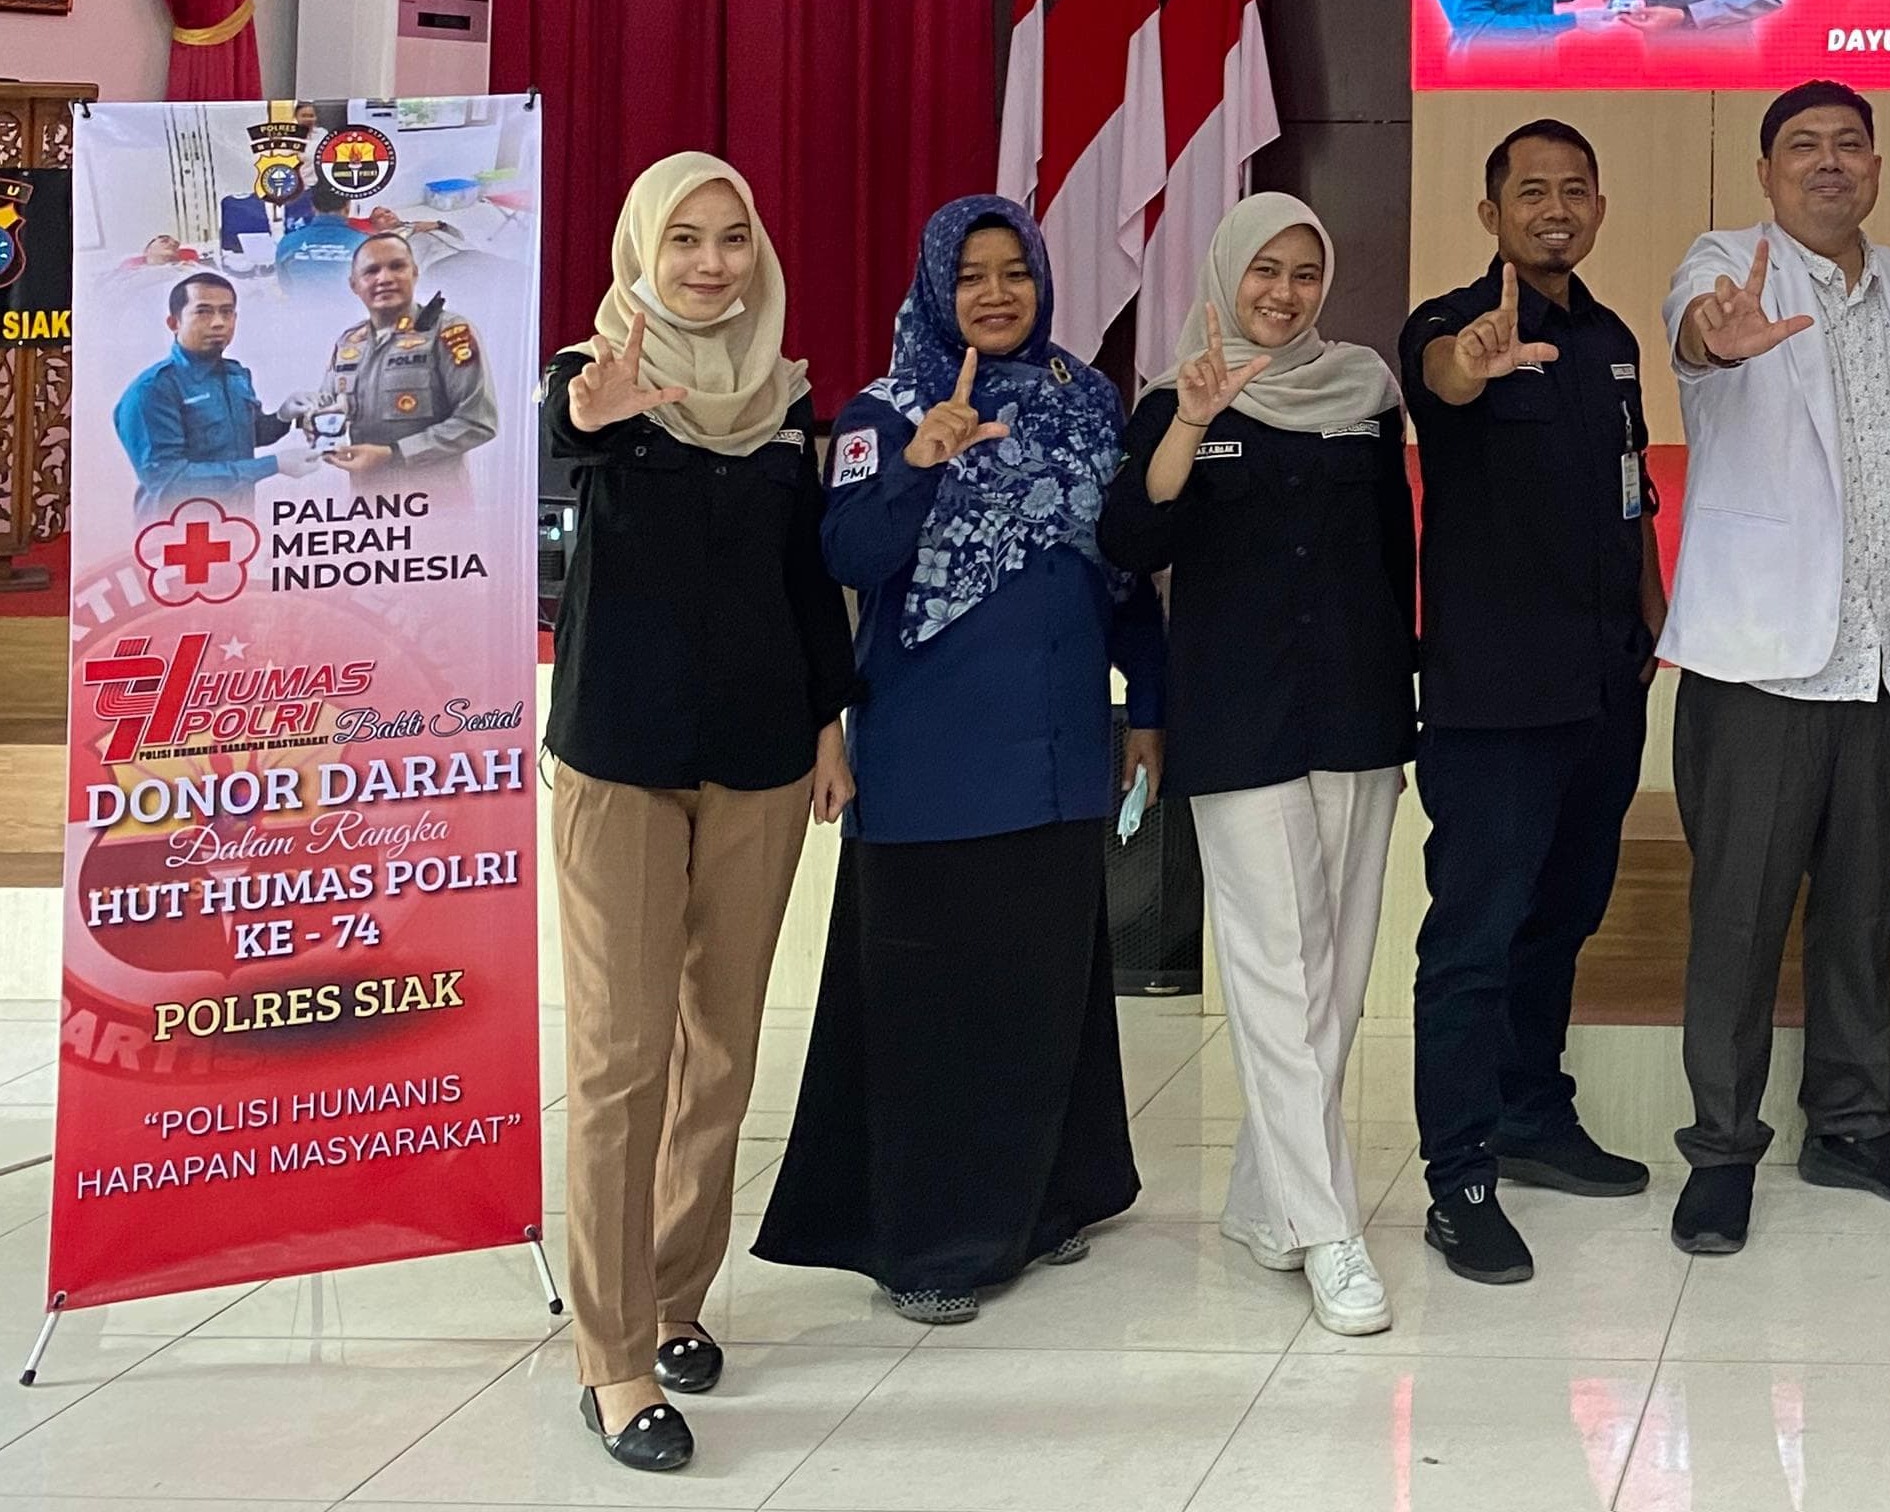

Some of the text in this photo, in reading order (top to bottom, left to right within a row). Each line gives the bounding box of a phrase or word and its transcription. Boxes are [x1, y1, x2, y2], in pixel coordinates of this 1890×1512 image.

[2, 310, 72, 339] SIAK
[272, 491, 429, 526] PALANG
[272, 525, 412, 559] MERAH
[271, 553, 488, 592] INDONESIA
[189, 659, 376, 707] HUMAS
[175, 699, 324, 745] POLRI
[334, 698, 524, 744] Bakti Sosial
[139, 735, 329, 761] POLISI HUMANIS HARAPAN MASYARAKAT
[85, 748, 523, 829] DONOR DARAH
[165, 810, 449, 868] Dalam Rangka
[87, 850, 518, 927] HUT HUMAS POLRI
[234, 921, 294, 961] KE
[331, 912, 380, 949] 74
[153, 984, 343, 1041] POLRES
[353, 971, 466, 1019] SIAK
[143, 1074, 463, 1140] “POLISI HUMANIS
[77, 1113, 521, 1200] HARAPAN MASYARAKAT”
